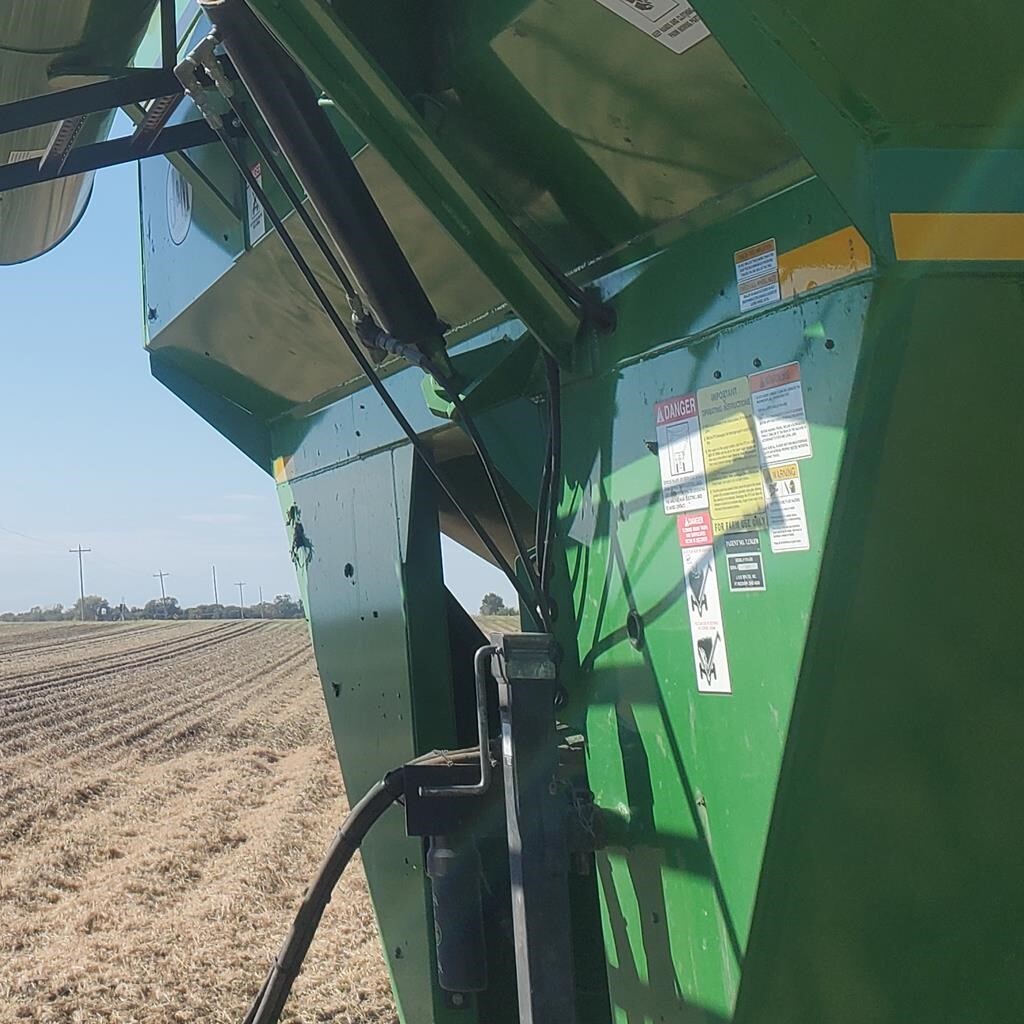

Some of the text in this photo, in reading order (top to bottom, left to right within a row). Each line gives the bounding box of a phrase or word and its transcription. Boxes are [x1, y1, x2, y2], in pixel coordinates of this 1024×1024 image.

[663, 397, 697, 420] DANGER
[714, 522, 724, 532] FOR
[725, 519, 740, 532] FARM
[752, 516, 766, 529] ONLY
